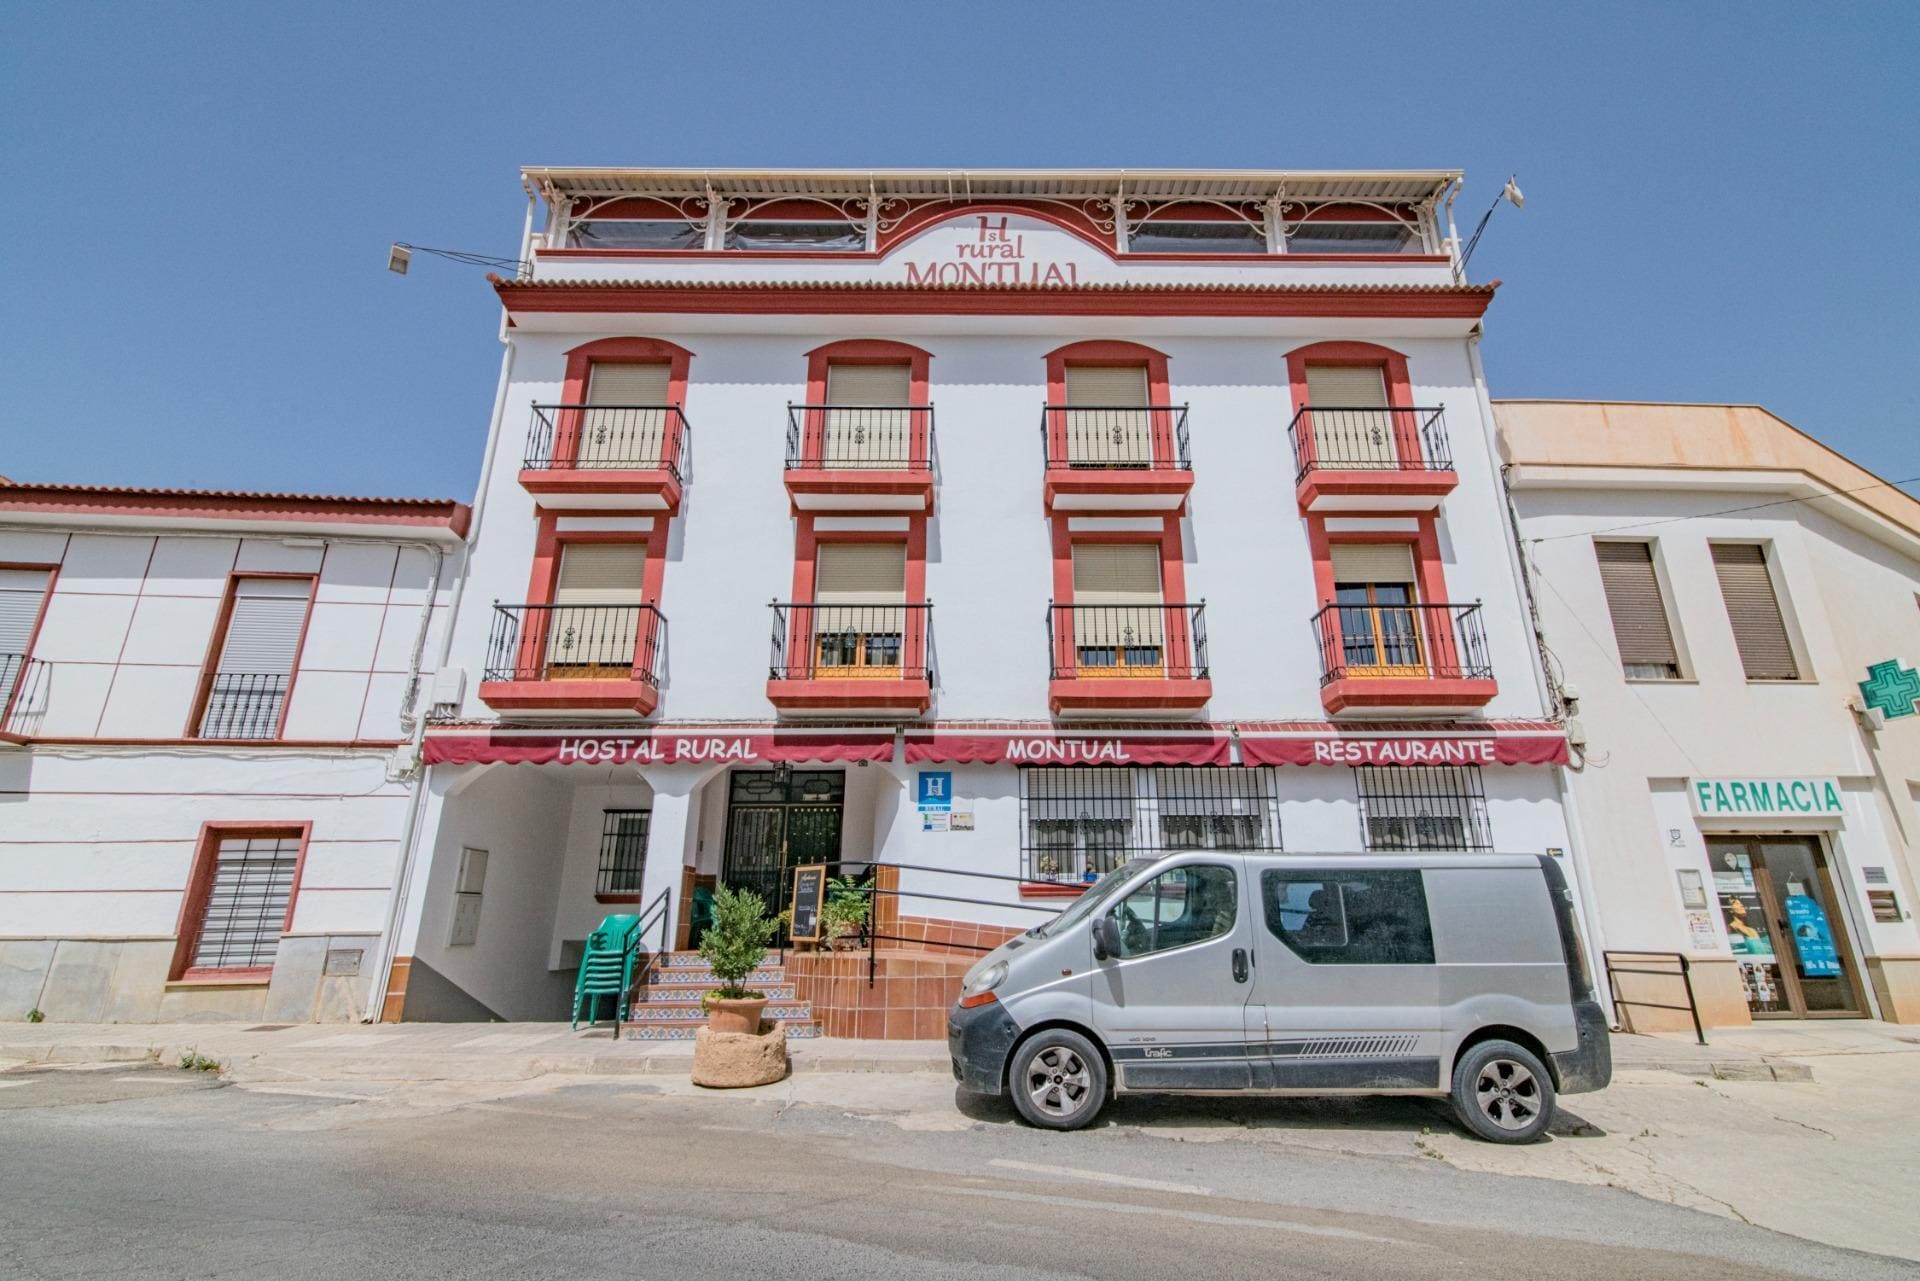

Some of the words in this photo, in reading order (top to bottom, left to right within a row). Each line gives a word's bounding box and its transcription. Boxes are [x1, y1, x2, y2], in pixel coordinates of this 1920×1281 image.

[956, 234, 1025, 258] rural
[559, 738, 665, 760] HOSTAL
[675, 738, 758, 759] RURAL
[1005, 739, 1130, 759] MONTUAL
[1314, 740, 1496, 761] RESTAURANTE
[1696, 780, 1843, 812] FARMACIA
[1143, 1047, 1173, 1059] Trafic
